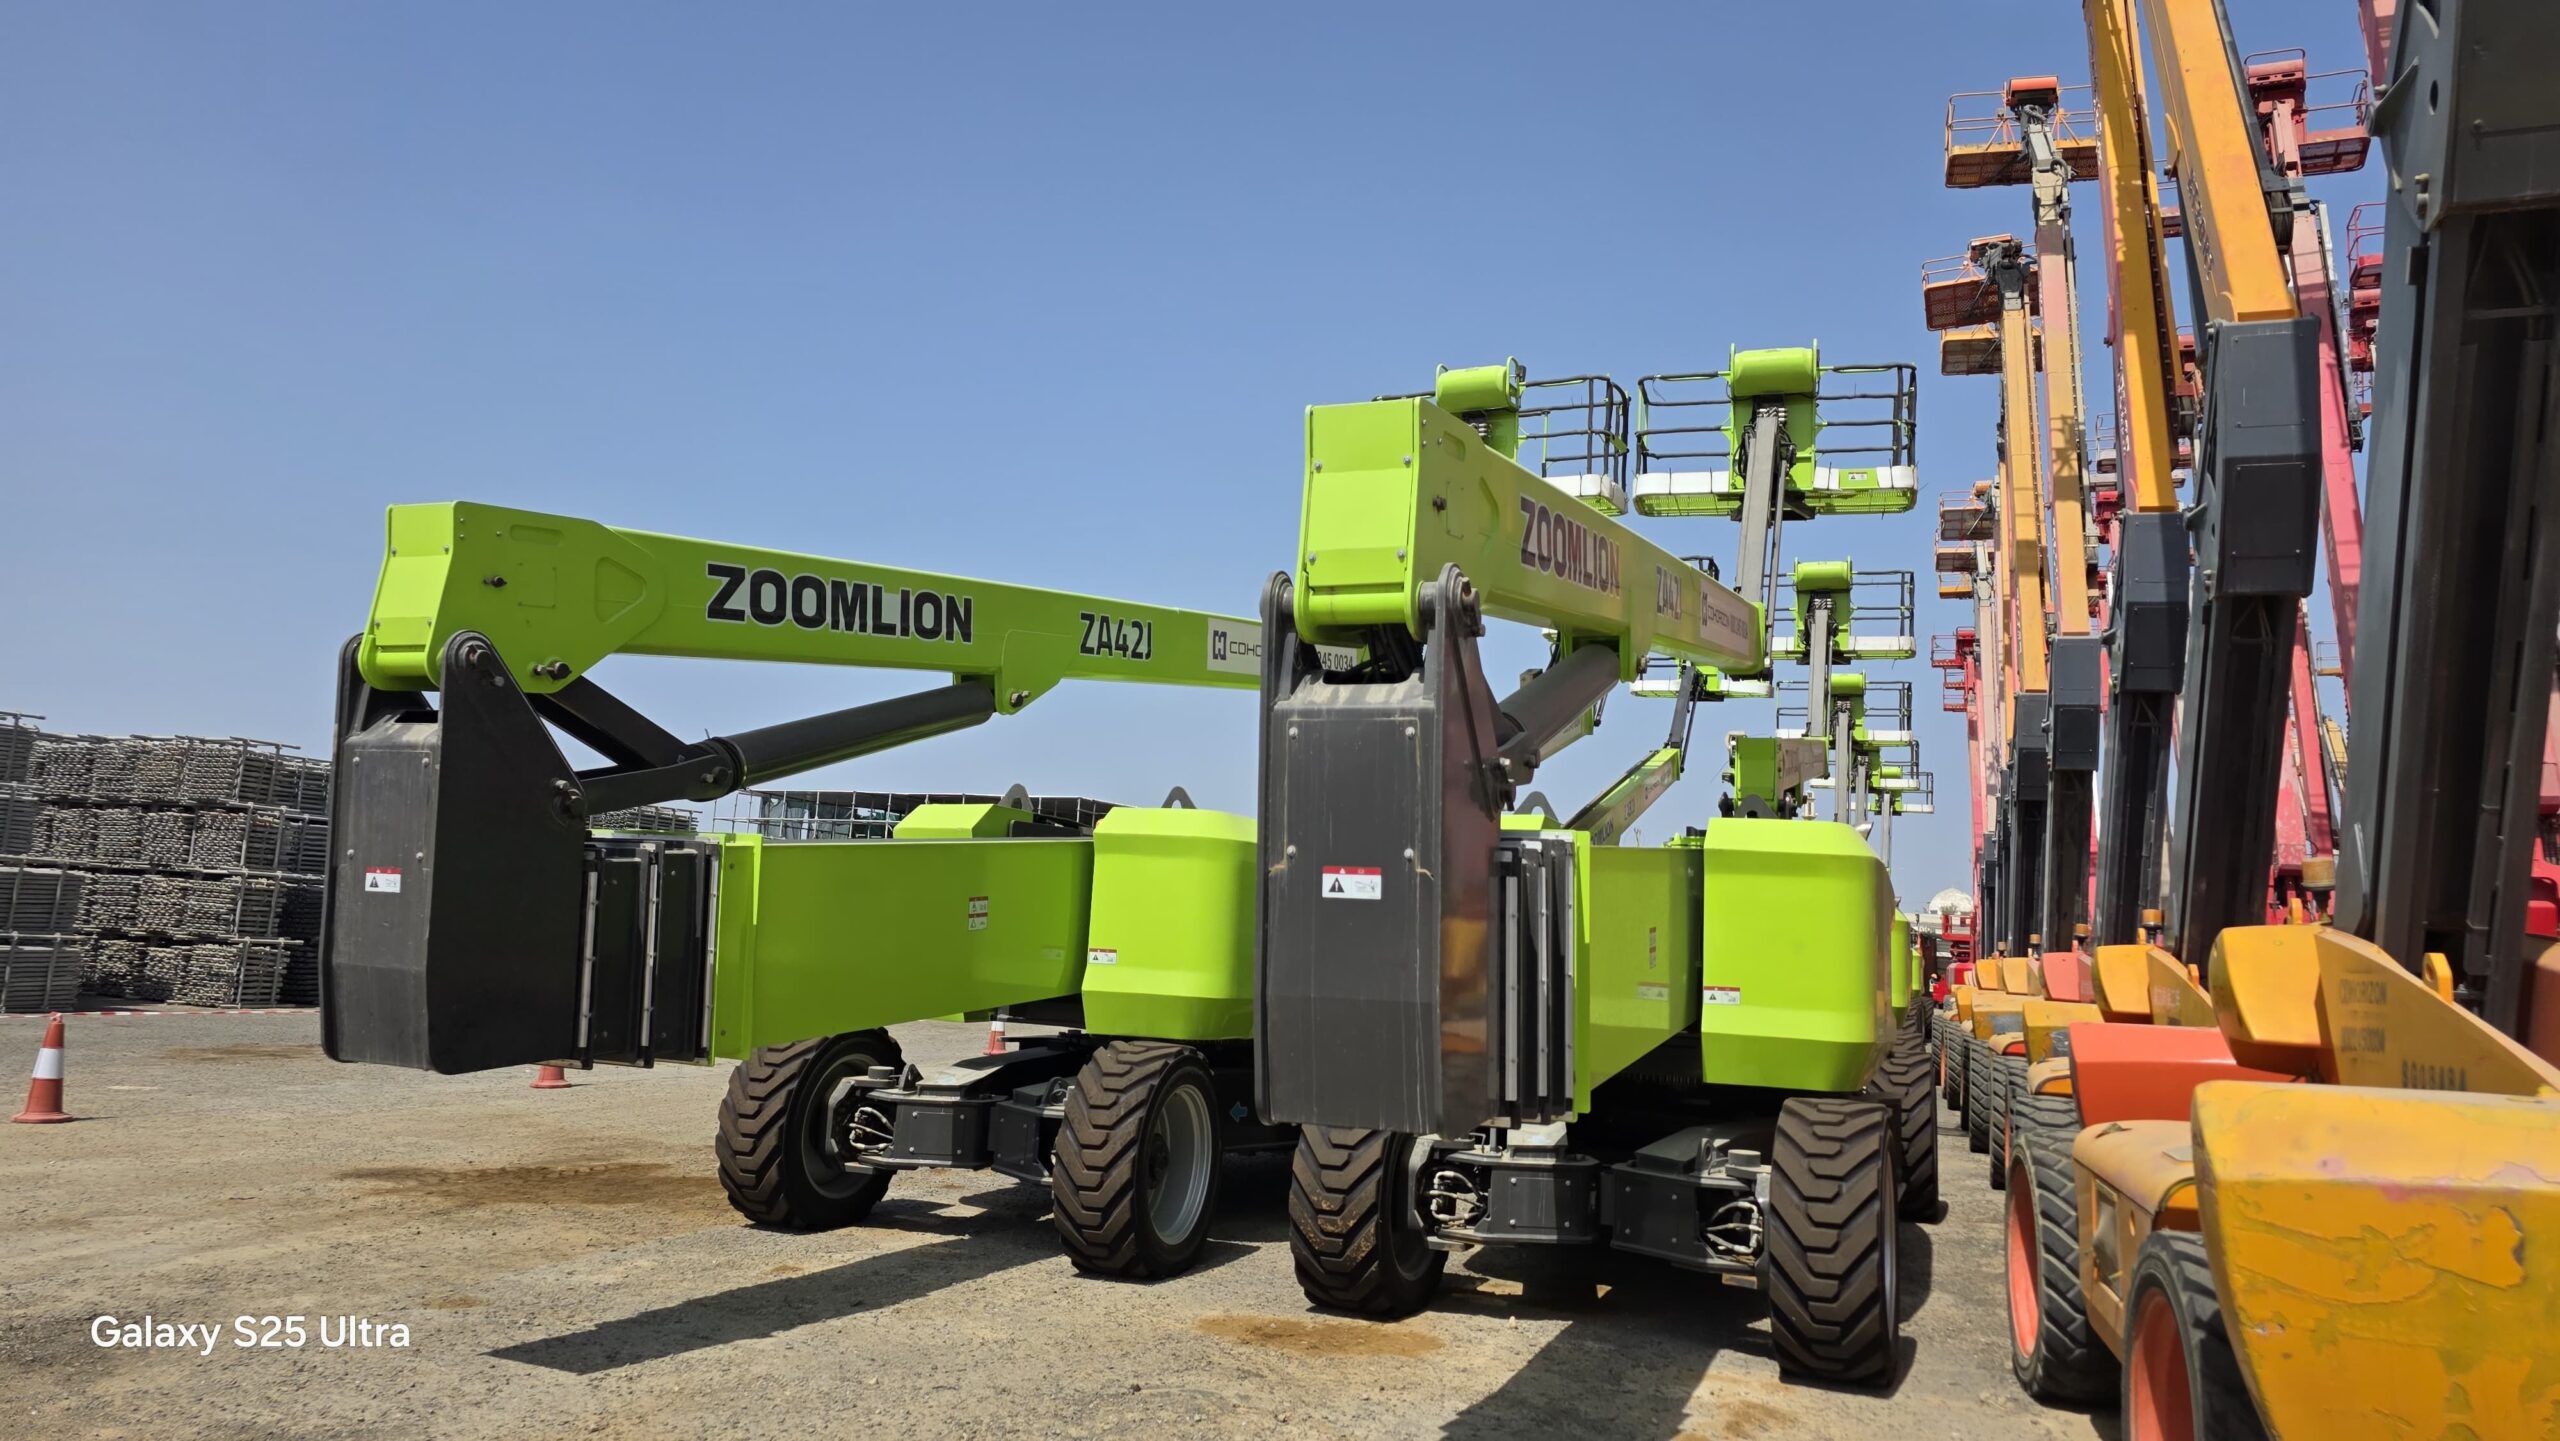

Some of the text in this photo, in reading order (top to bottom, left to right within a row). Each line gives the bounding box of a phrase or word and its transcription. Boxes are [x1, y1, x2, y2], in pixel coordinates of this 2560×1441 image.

[1520, 494, 1621, 597] ZOOMLION
[707, 562, 973, 644] ZOOMLION
[1080, 611, 1153, 661] ZA42J
